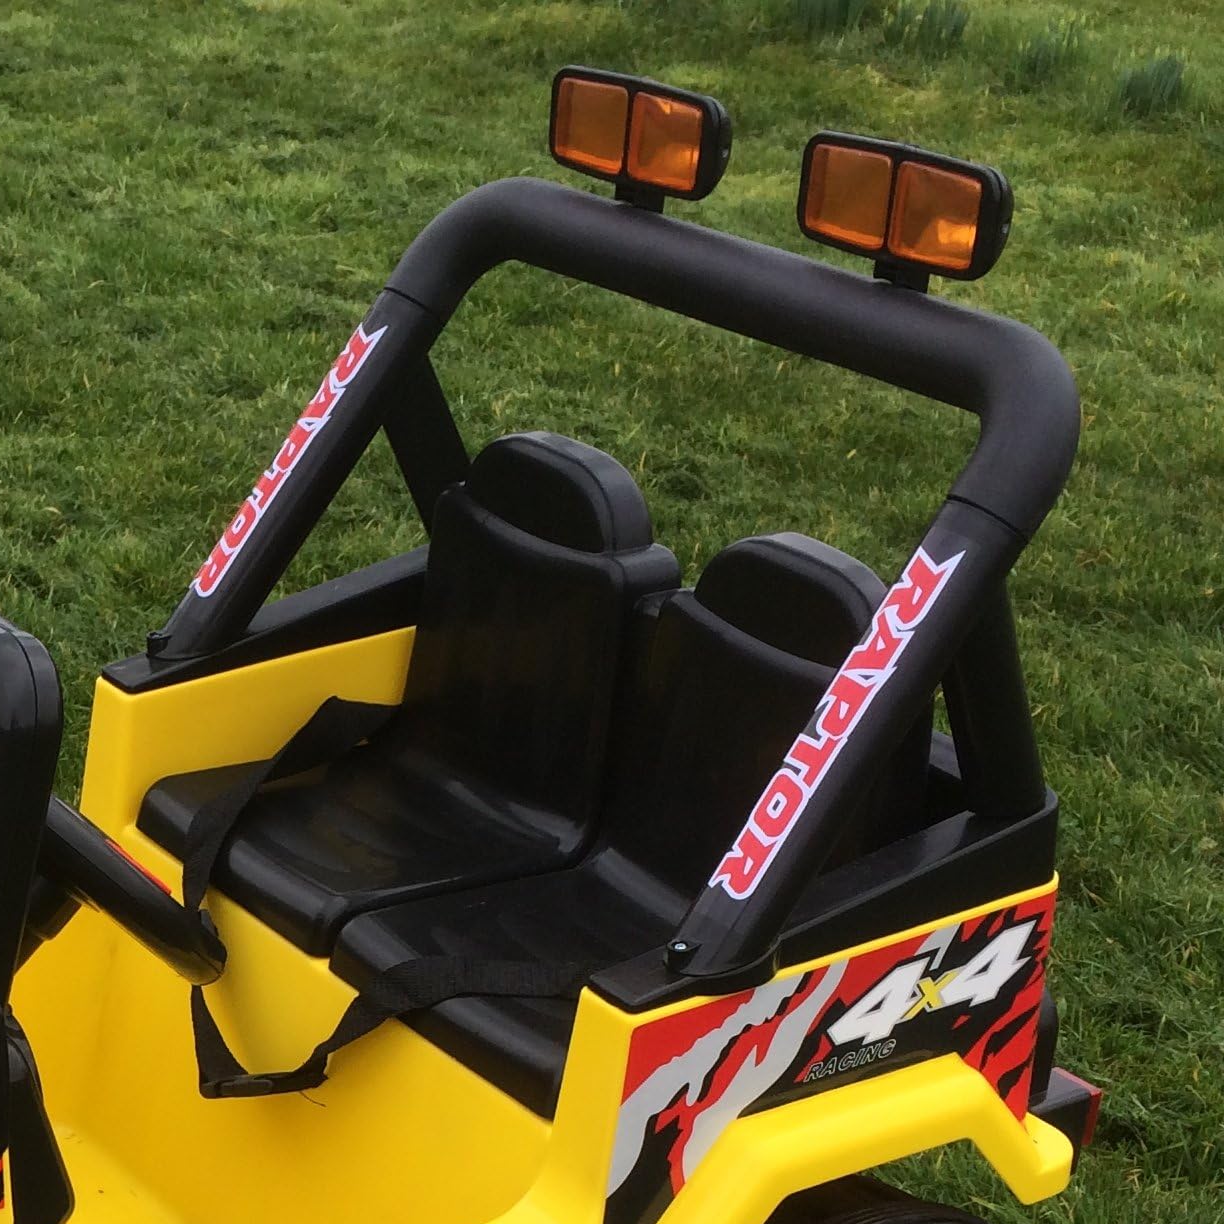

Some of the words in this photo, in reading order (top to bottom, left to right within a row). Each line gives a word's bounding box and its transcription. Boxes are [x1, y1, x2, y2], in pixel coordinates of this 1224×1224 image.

[189, 323, 388, 597] RAPTOR
[708, 546, 966, 900] RAPTOR
[804, 1039, 897, 1083] RACING
